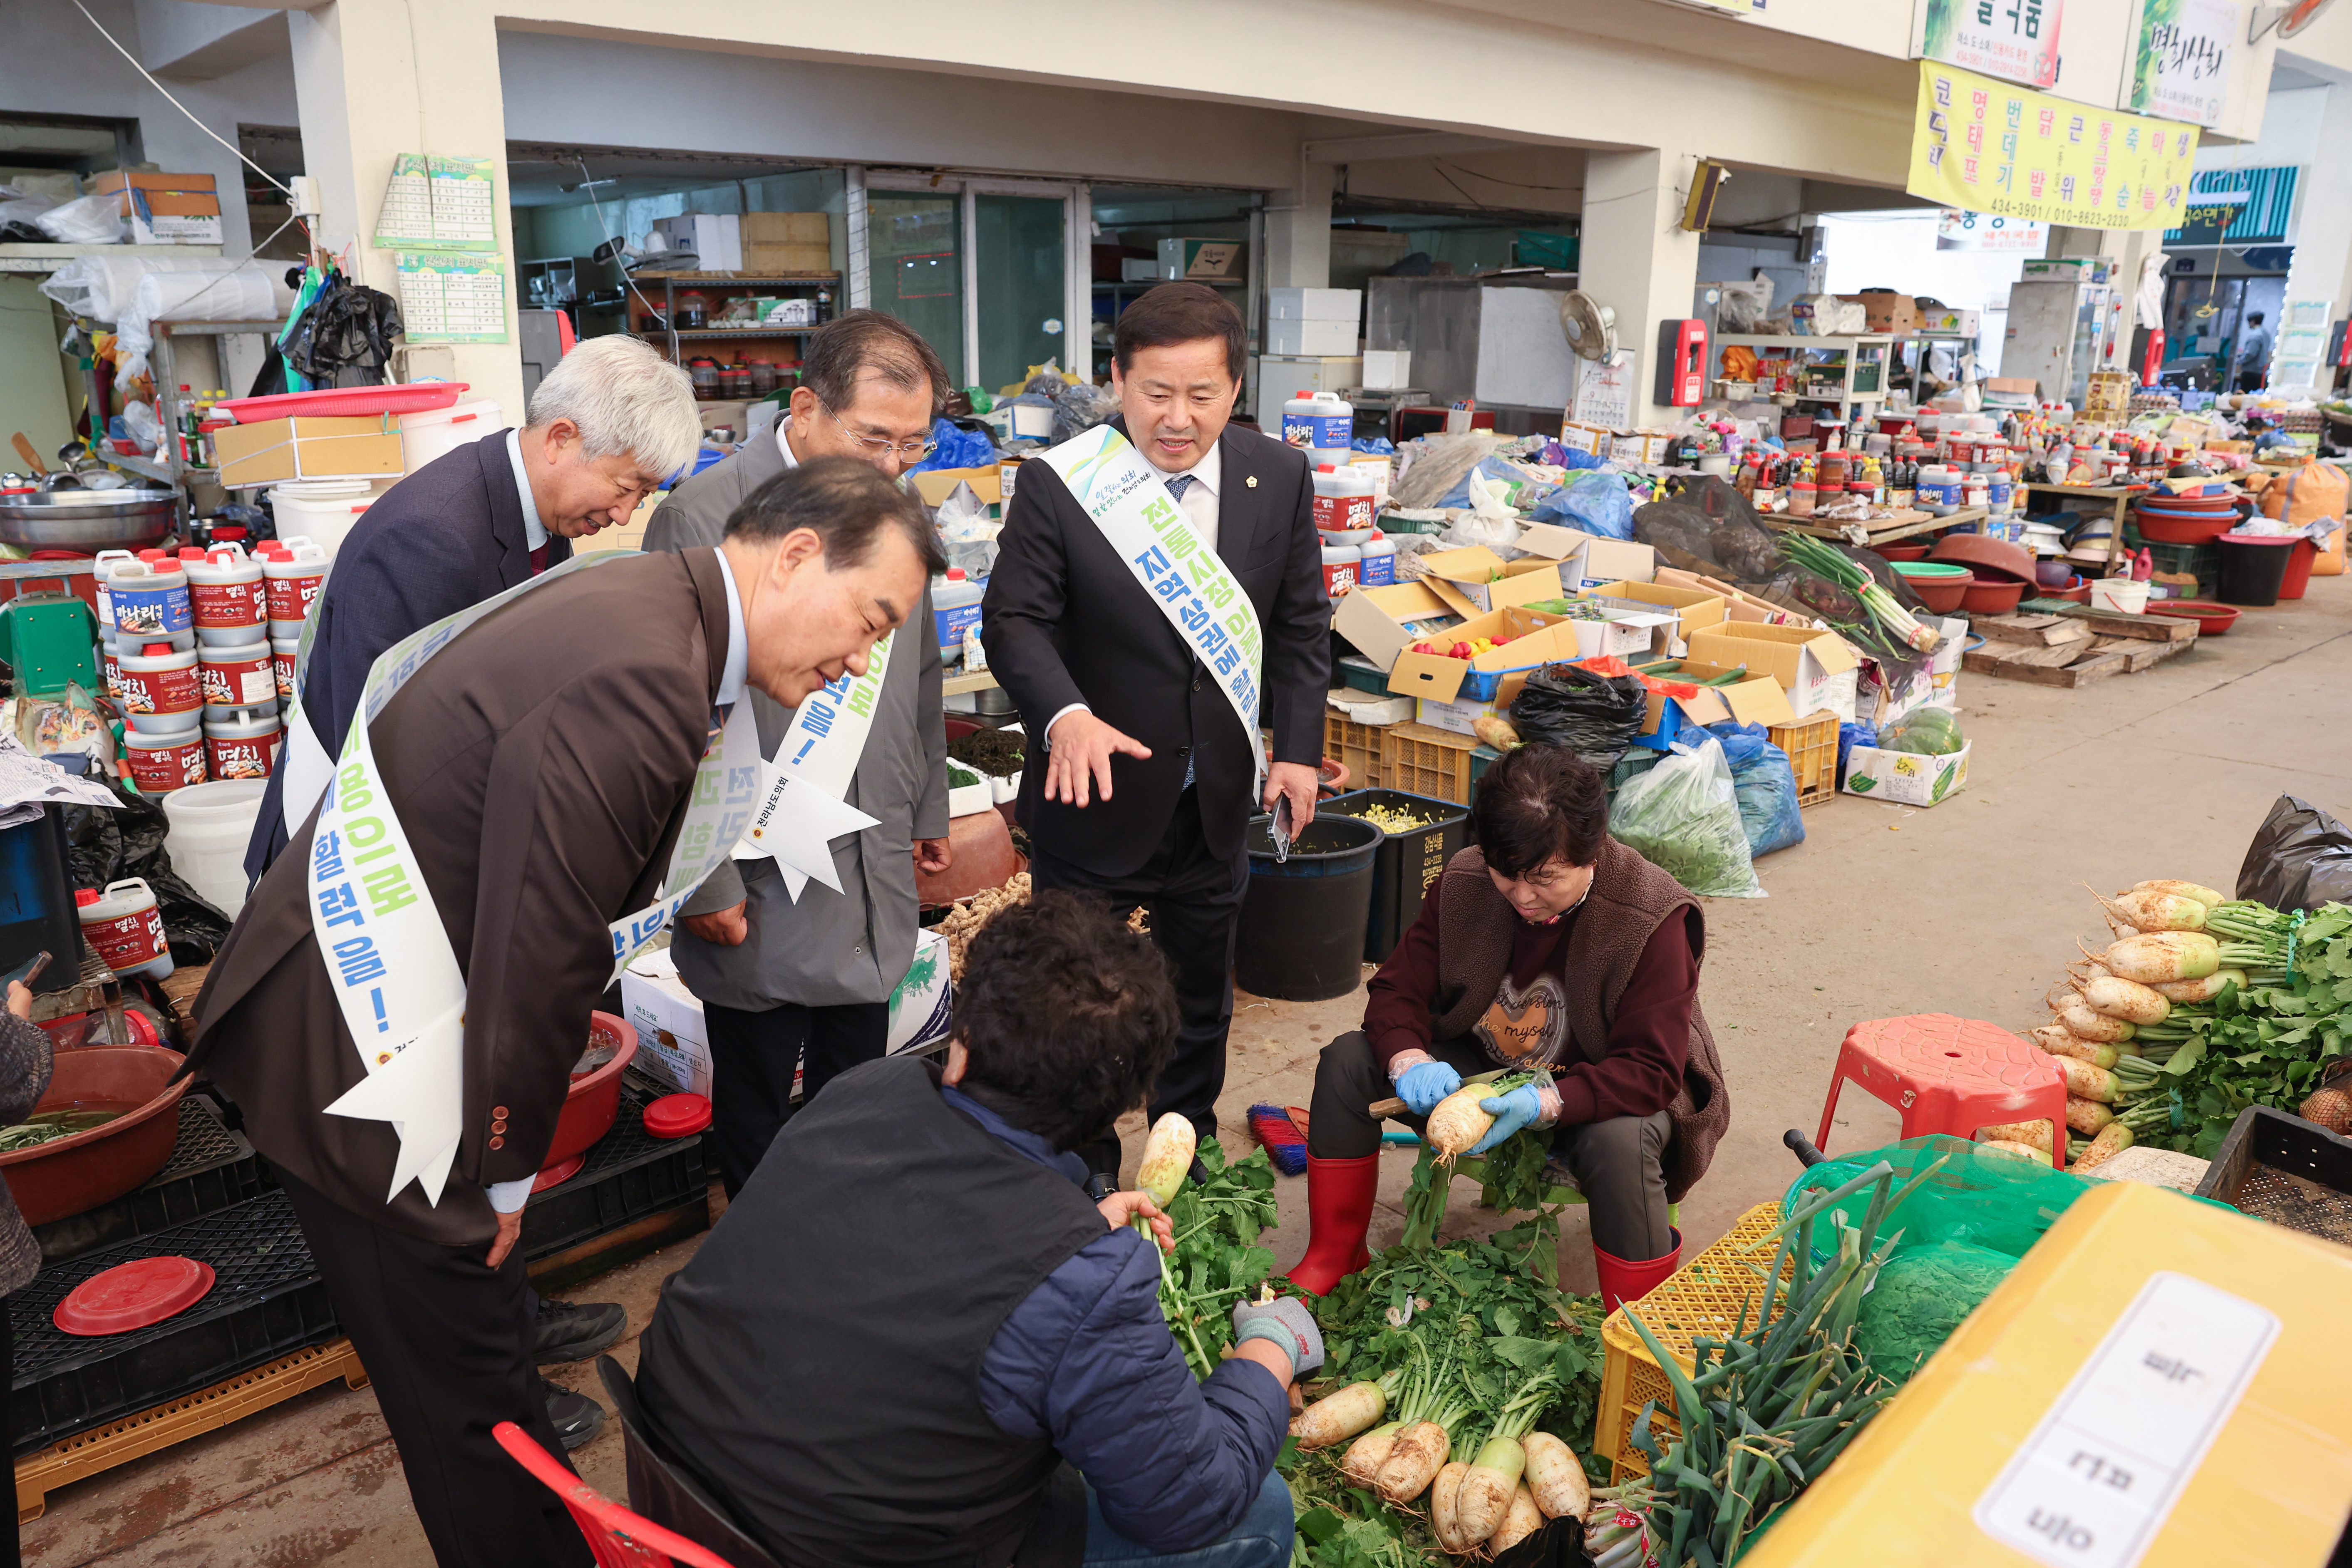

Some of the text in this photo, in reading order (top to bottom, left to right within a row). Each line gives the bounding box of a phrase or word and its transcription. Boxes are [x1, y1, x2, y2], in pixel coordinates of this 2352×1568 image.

[1963, 90, 1987, 183] 명태포
[1997, 100, 2022, 192] 번데기
[2031, 109, 2054, 197] 닭발
[2090, 122, 2112, 206] 동그랑땡
[2117, 127, 2139, 208] 죽순
[2143, 131, 2165, 209] 마늘
[2165, 133, 2190, 208] 생강
[1991, 198, 2042, 218] 434-3901
[1121, 470, 1136, 484] 의회
[1122, 472, 1151, 494] 전라남도의회
[1348, 501, 1370, 523] 멸치
[1141, 496, 1235, 609] 전통시장
[1332, 567, 1354, 590] 멸치
[226, 585, 245, 598] 멸치
[115, 604, 156, 622] 까나리
[1135, 545, 1241, 676] 지역상권에
[150, 750, 171, 764] 멸치
[217, 745, 258, 773] 멸치
[757, 776, 789, 828] 전라남도의회
[114, 916, 137, 933] 멸치
[645, 1037, 656, 1048] 국내산
[689, 1057, 702, 1069] 생산자
